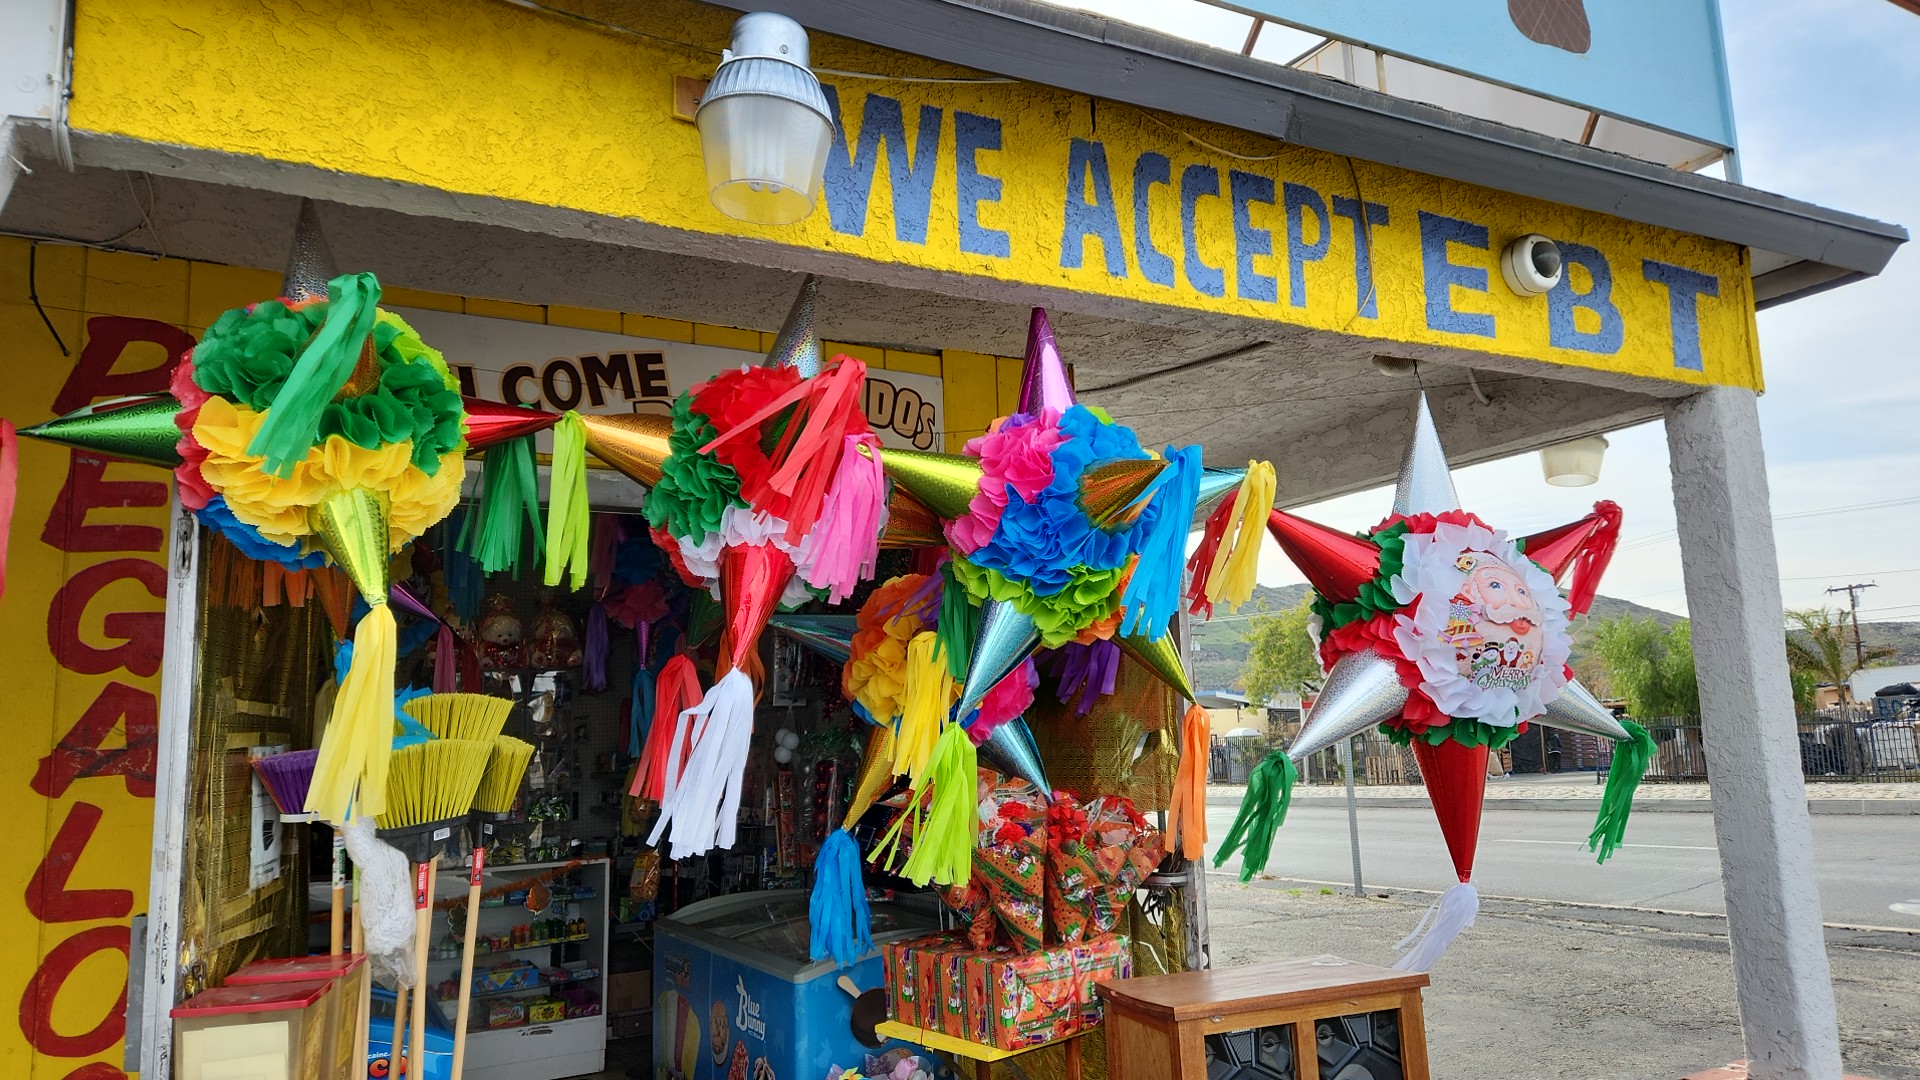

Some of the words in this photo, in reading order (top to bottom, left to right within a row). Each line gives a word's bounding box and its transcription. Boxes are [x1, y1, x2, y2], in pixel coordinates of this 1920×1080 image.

[819, 83, 1010, 259] WE
[1060, 137, 1390, 320] ACCEPT
[1491, 665, 1530, 680] MERRY
